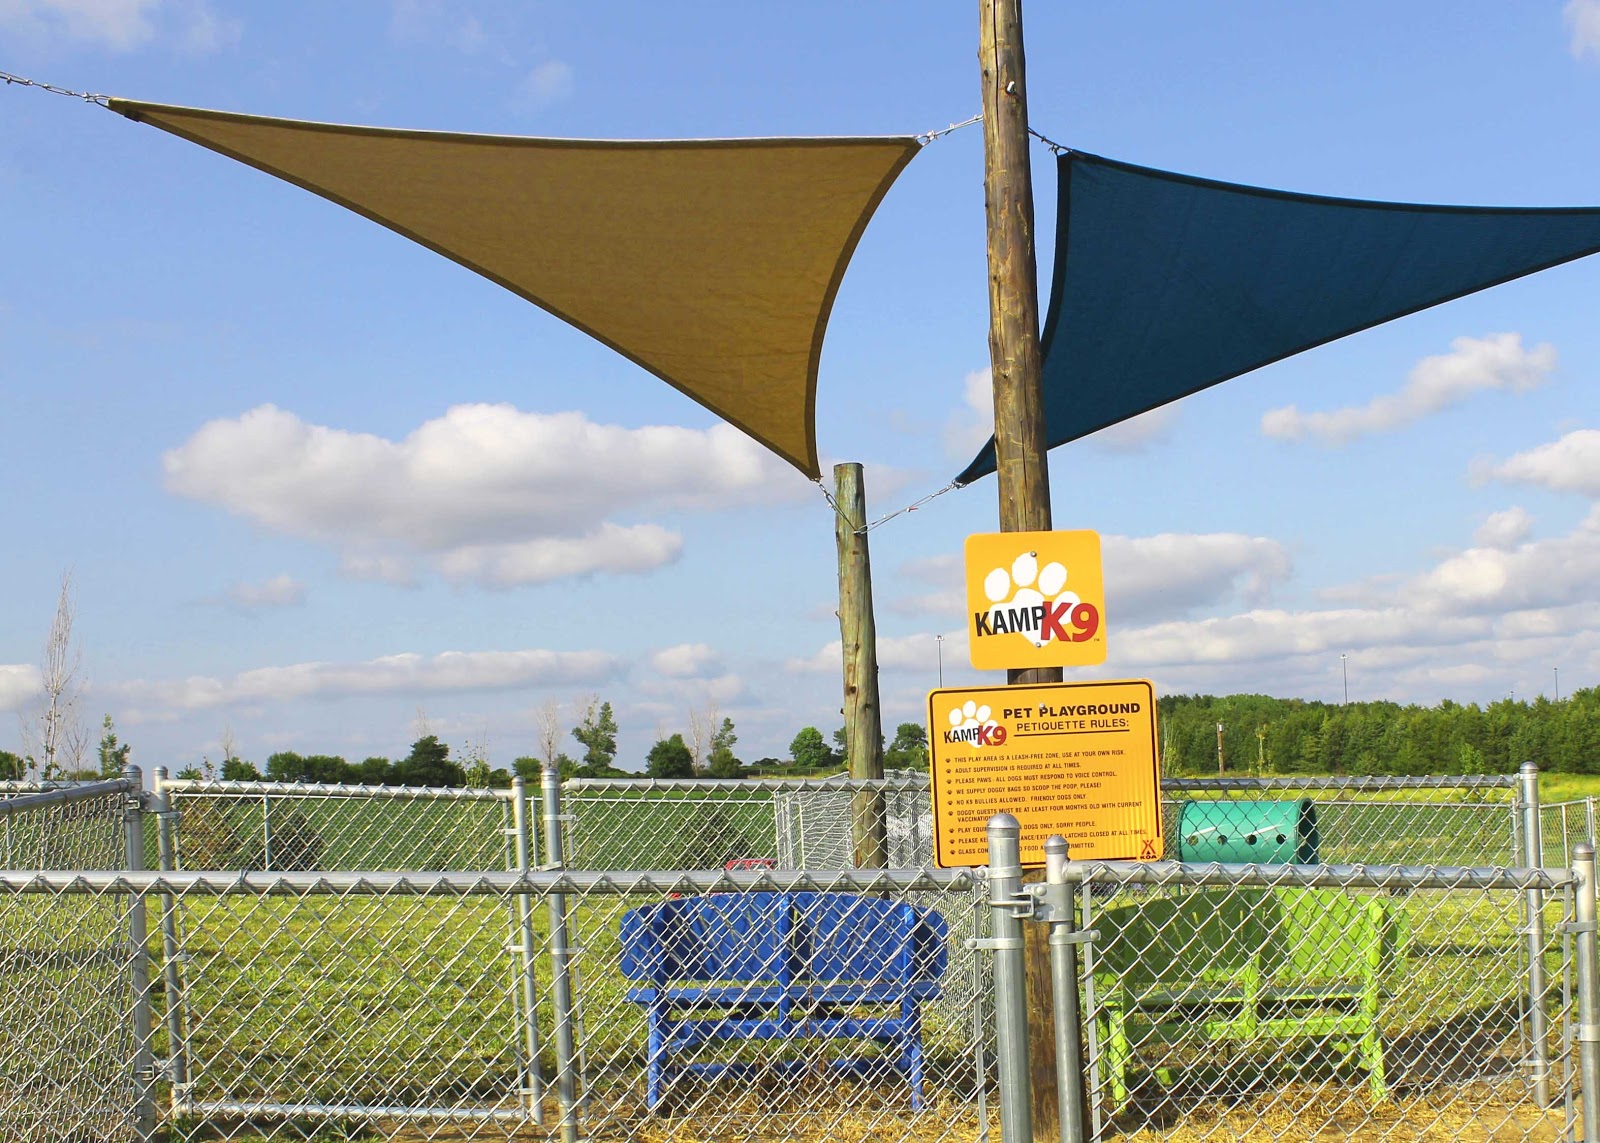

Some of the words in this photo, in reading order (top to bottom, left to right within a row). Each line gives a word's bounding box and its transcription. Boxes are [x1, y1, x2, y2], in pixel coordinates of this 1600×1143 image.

[1004, 708, 1032, 719] PET
[1039, 703, 1140, 718] PLAYGROUND
[1017, 720, 1086, 731] PETIQUETTE
[1090, 718, 1130, 728] RULES:
